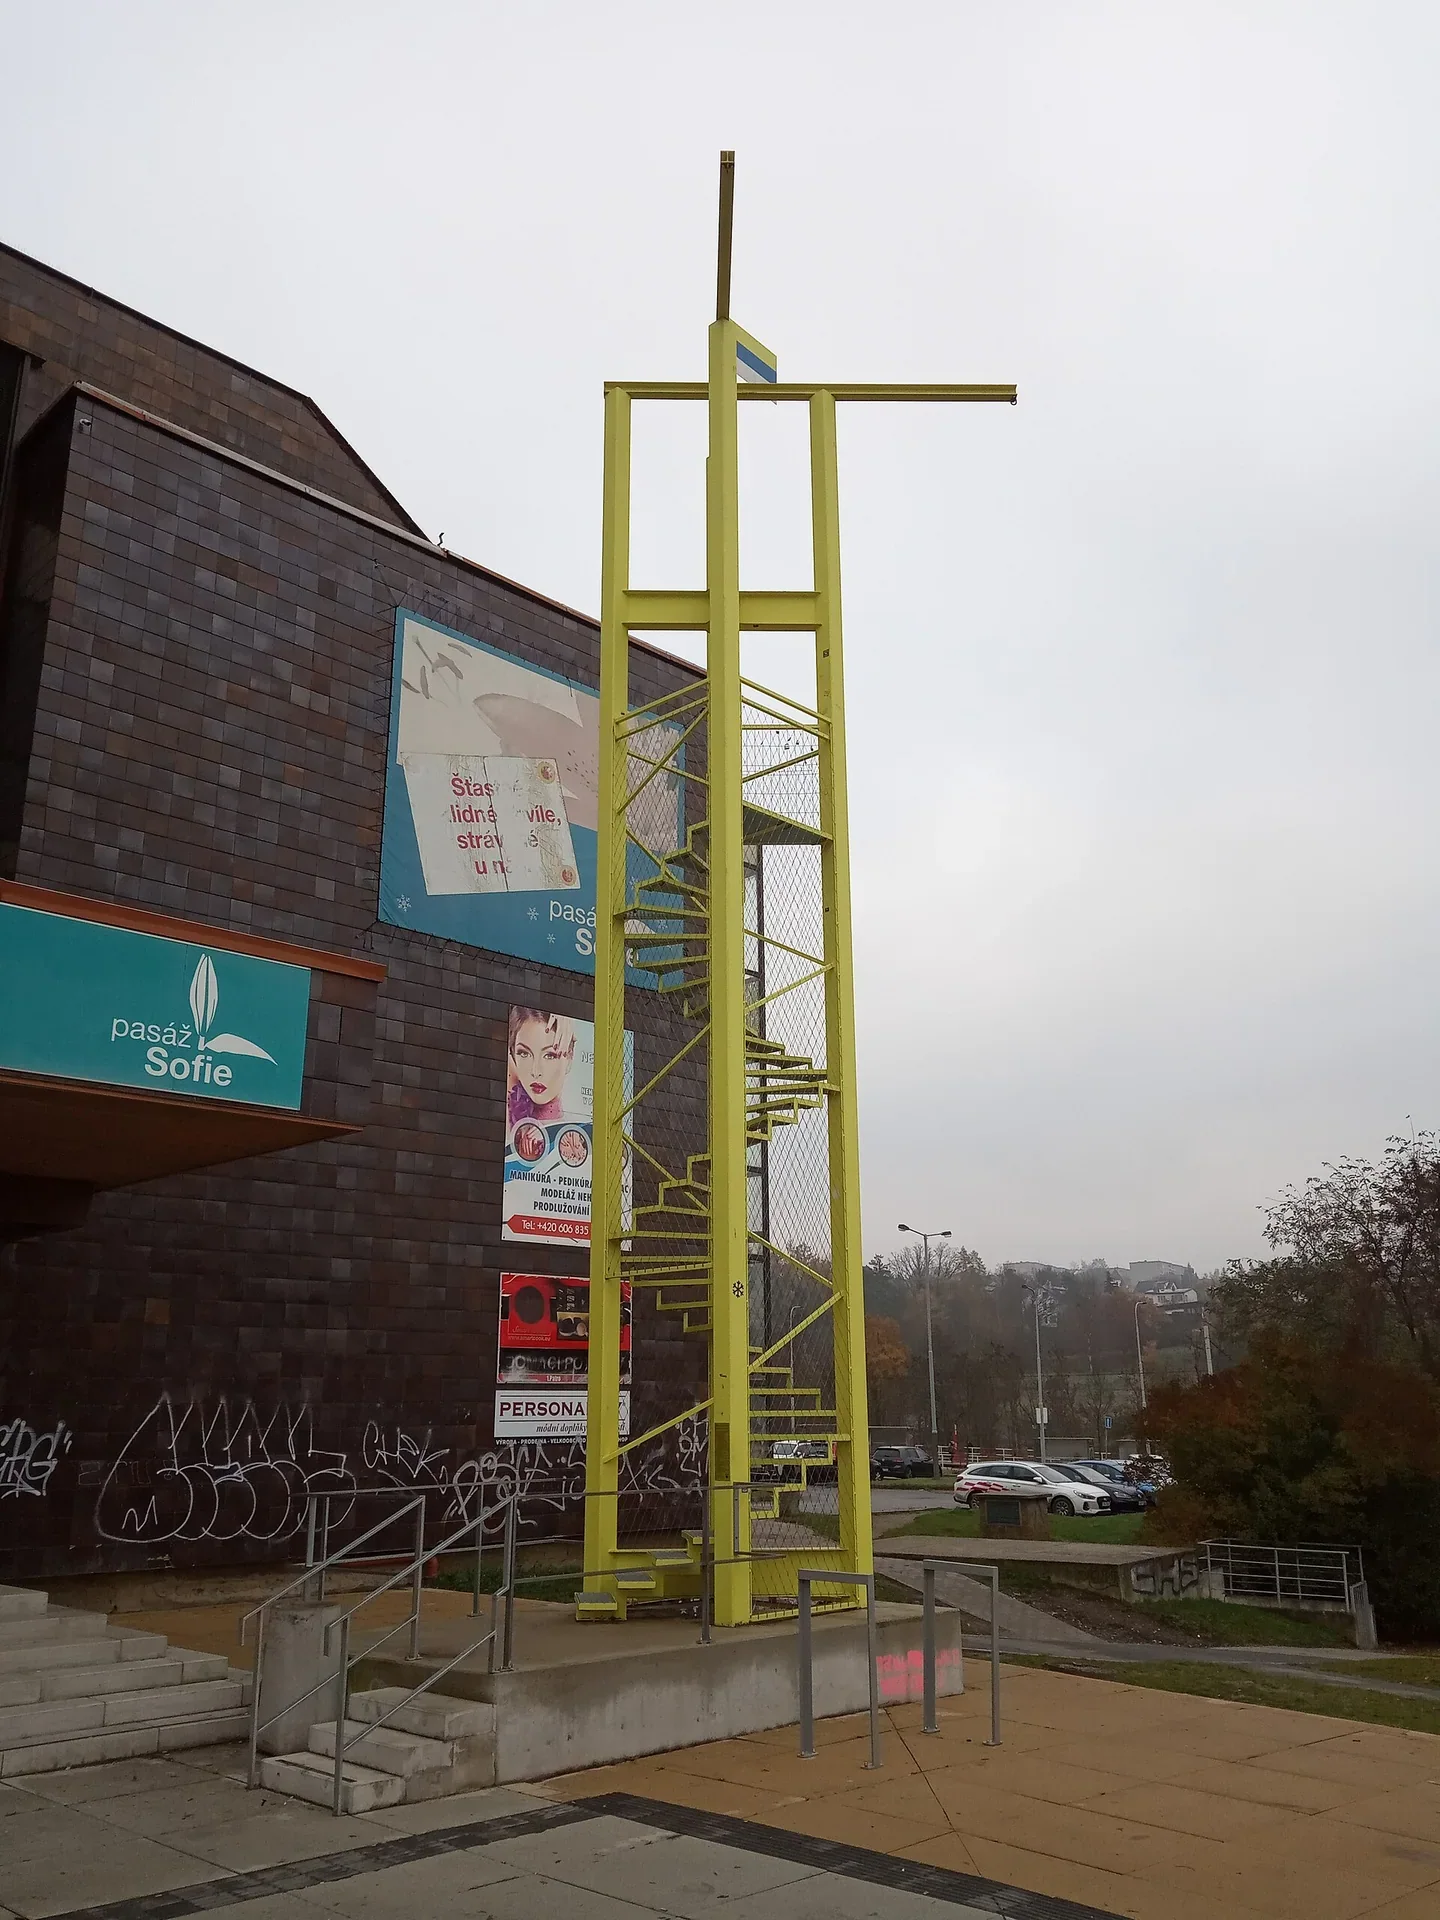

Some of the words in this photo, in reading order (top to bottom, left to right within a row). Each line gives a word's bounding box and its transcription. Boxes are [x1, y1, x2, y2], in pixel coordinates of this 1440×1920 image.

[449, 804, 498, 823] lidné
[475, 860, 488, 875] u
[549, 899, 596, 927] pasá
[111, 1018, 193, 1048] pasáž
[144, 1046, 233, 1087] Sofie
[509, 1170, 551, 1184] MANIKÚRA
[540, 1187, 576, 1201] MODELÁŽ
[577, 1193, 592, 1202] NEH
[533, 1201, 590, 1216] PRODLUŽOVÁNÍ
[537, 1222, 557, 1233] +420
[558, 1223, 574, 1235] 606
[574, 1225, 589, 1236] 835
[499, 1401, 588, 1417] PERSONA
[536, 1423, 559, 1433] módní
[559, 1423, 587, 1434] doplňky
